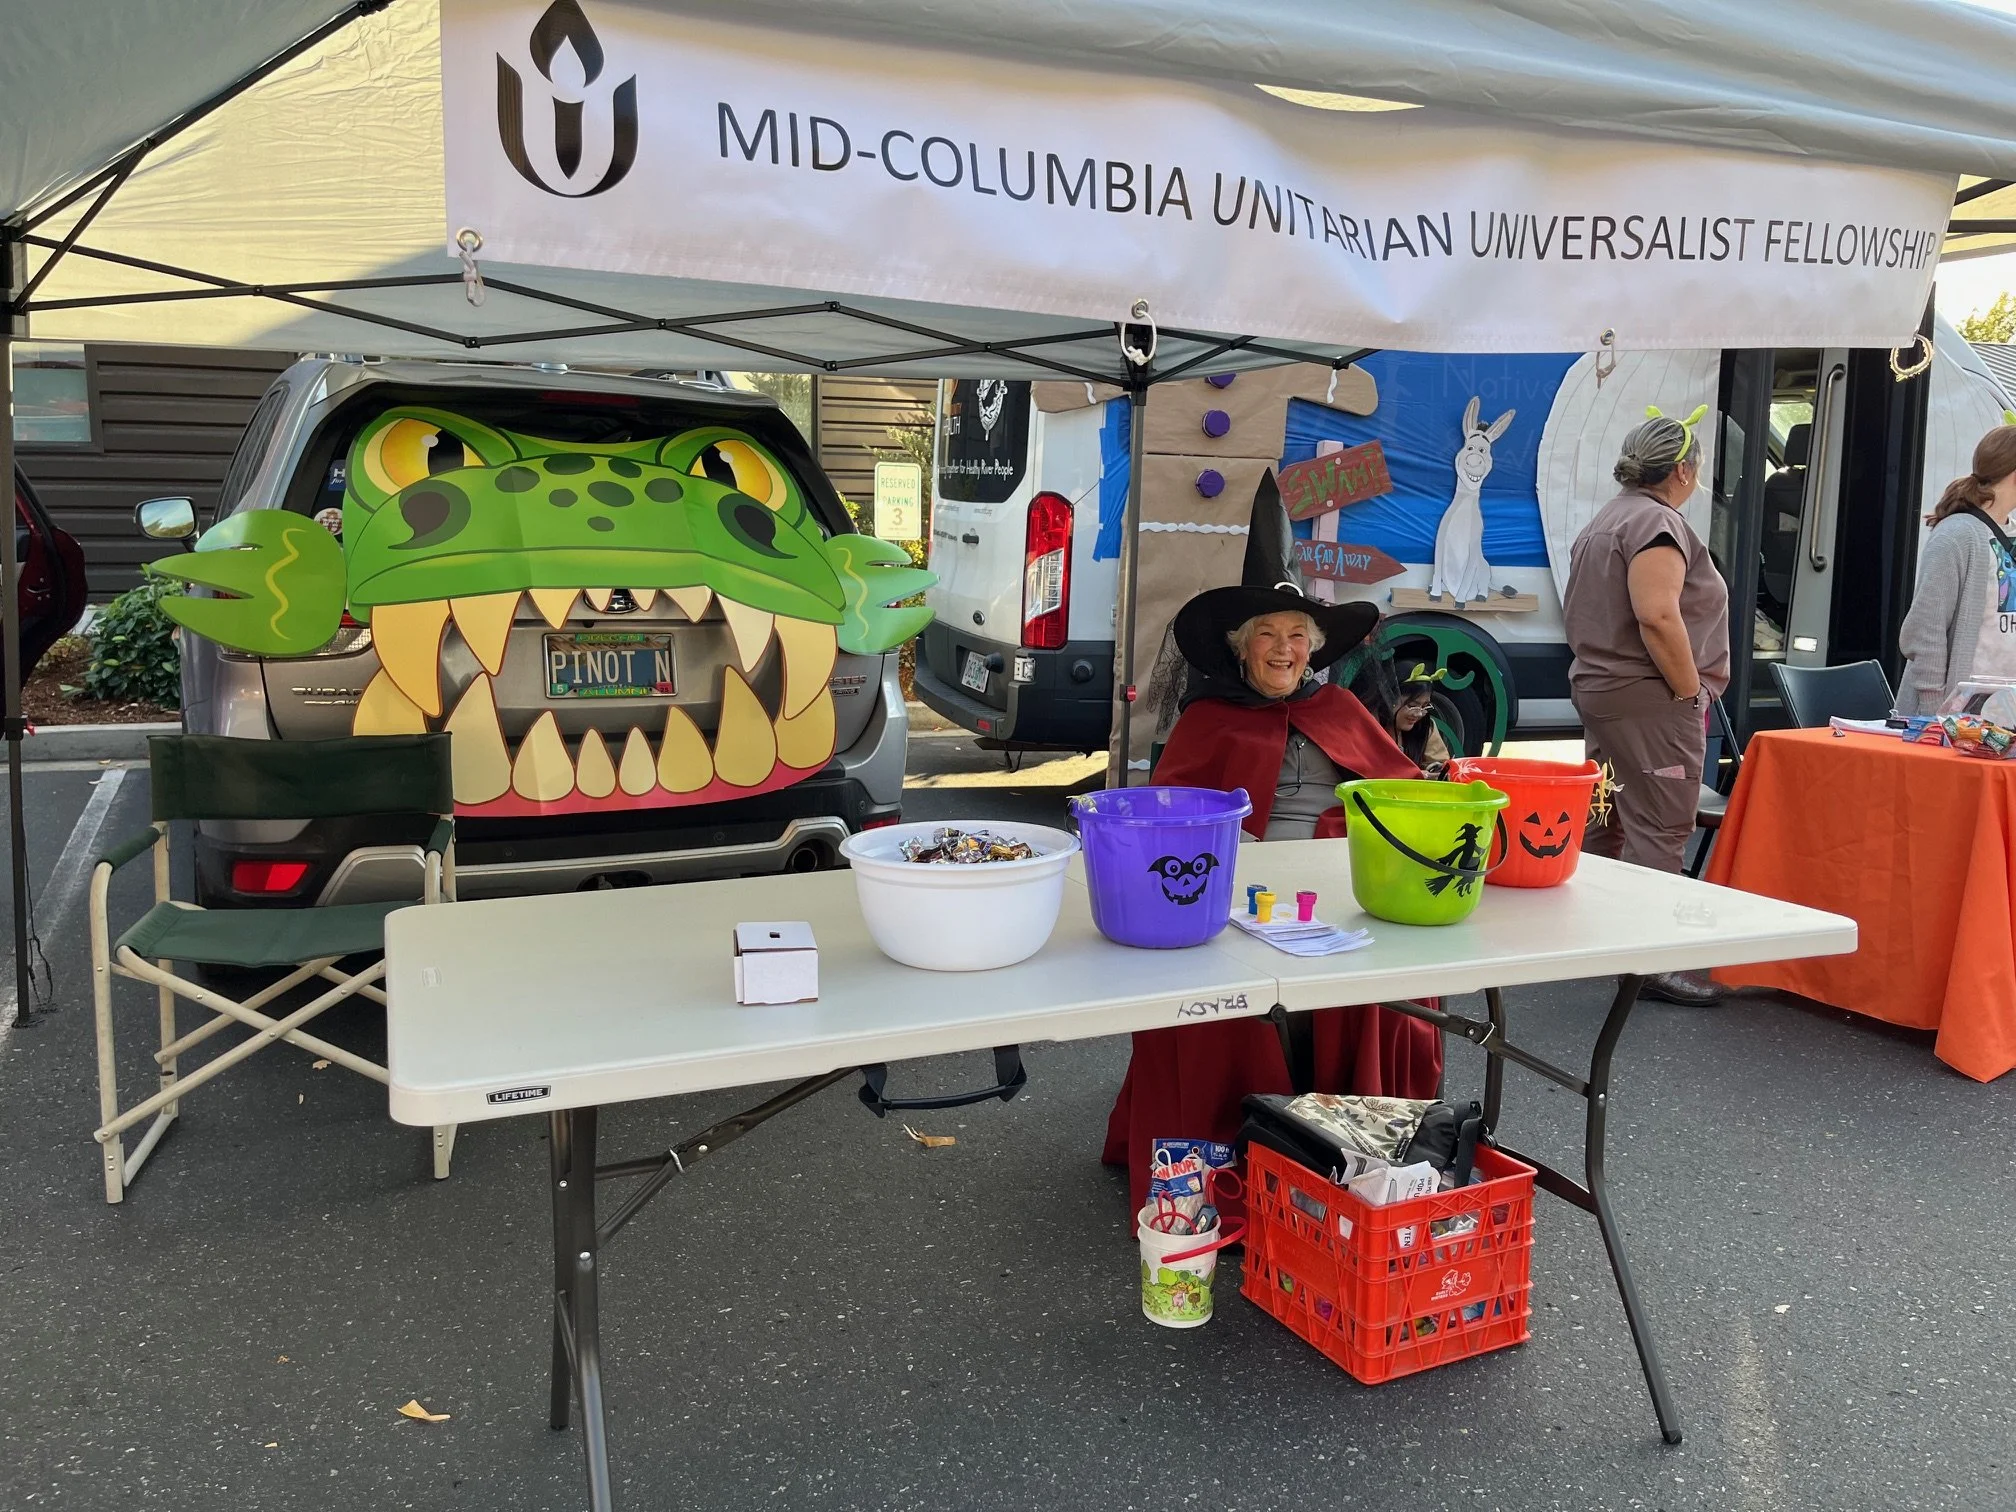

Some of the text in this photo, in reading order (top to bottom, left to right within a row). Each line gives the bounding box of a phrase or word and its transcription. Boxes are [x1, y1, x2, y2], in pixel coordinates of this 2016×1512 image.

[716, 101, 1942, 272] MID-COLUMBIA UNITARIAN UNIVERSALIST FELLOWSHIP
[981, 458, 994, 475] River
[994, 458, 1015, 481] People
[881, 478, 915, 489] RESERVED
[1287, 448, 1382, 516] SWAMP
[881, 496, 914, 507] PARKING
[892, 508, 903, 525] 3
[1314, 543, 1334, 572] FAR
[1332, 546, 1372, 577] AWAY
[551, 650, 672, 683] PINOT N
[556, 685, 564, 694] 5
[583, 688, 649, 697] ALUMNI
[1176, 993, 1249, 1019] BRADY
[494, 1089, 543, 1101] LIFETIME
[1172, 1159, 1198, 1176] ROPE
